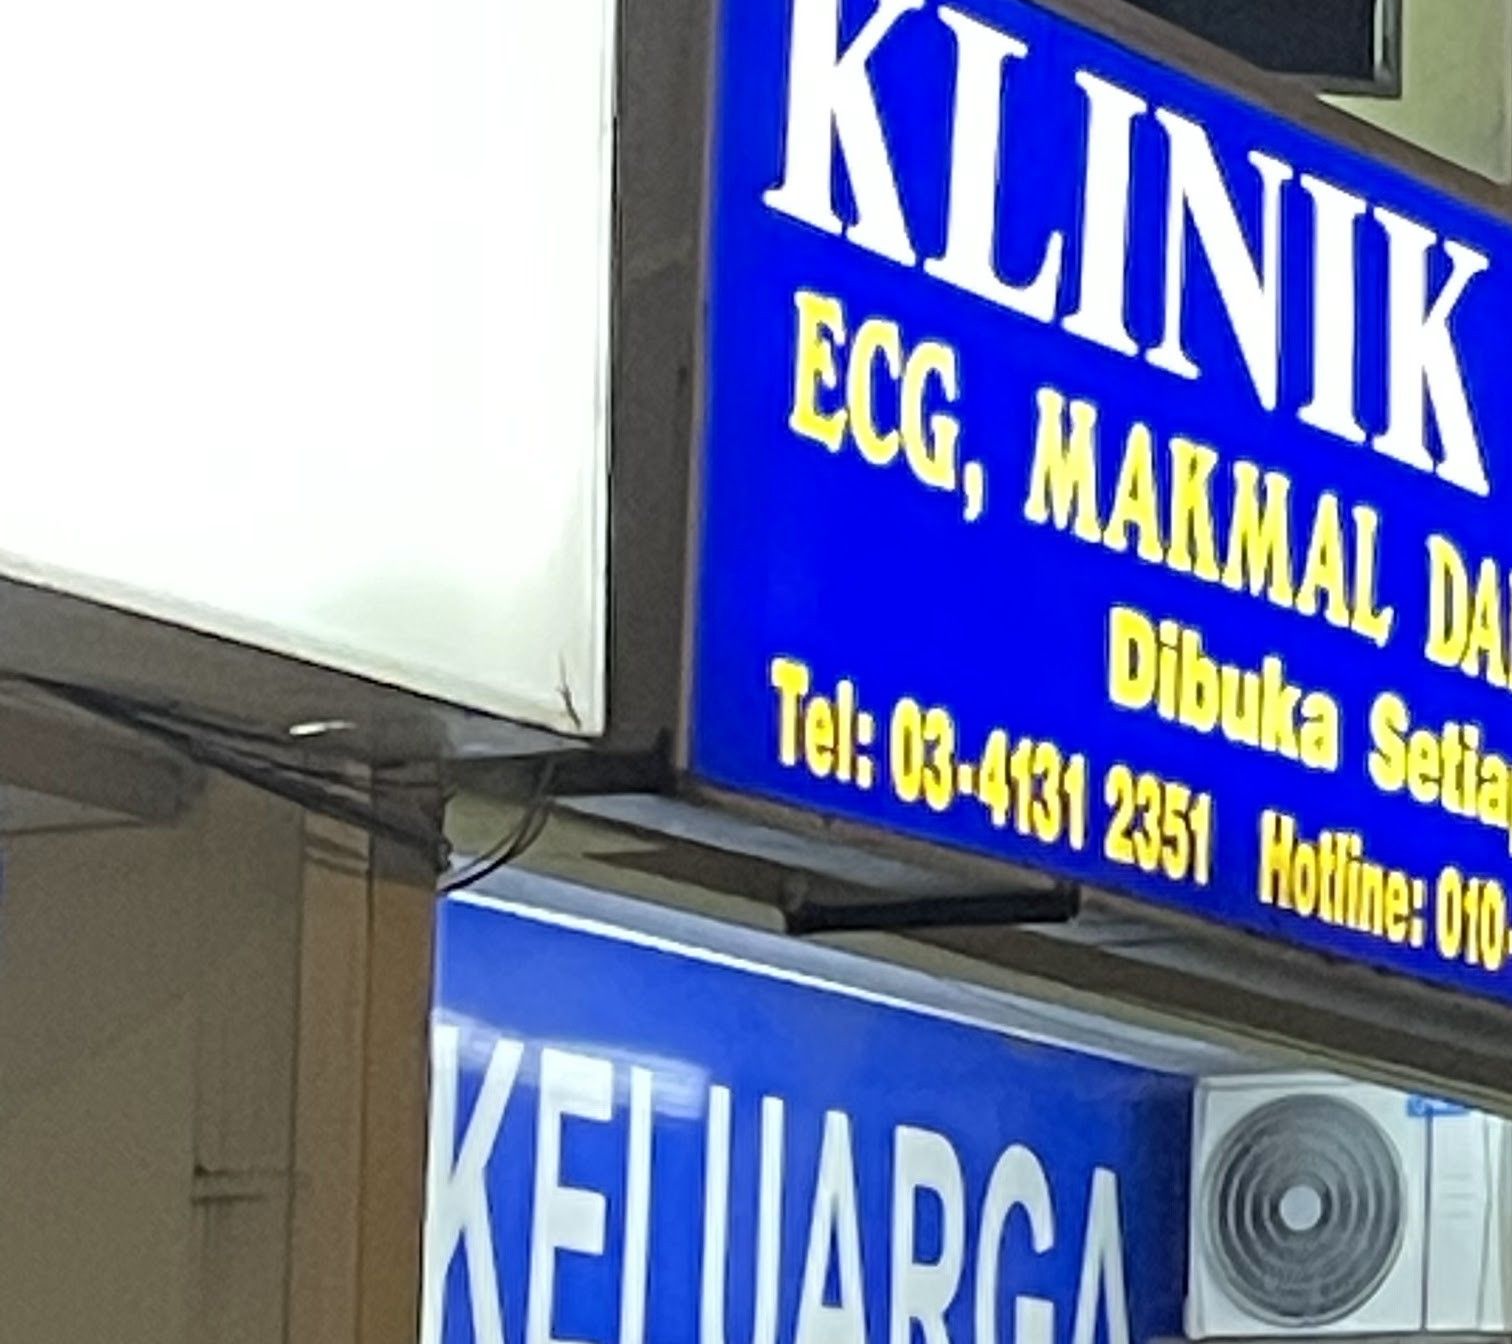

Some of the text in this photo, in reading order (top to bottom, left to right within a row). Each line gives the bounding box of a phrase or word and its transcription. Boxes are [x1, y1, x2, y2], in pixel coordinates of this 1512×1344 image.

[789, 290, 985, 521] ECG,
[1025, 388, 1393, 647] MAKMAL
[771, 659, 875, 789] Tel:
[890, 697, 1088, 850] 03-4131
[1105, 764, 1213, 885] 2351
[1259, 810, 1426, 948] Hotline:
[1108, 605, 1340, 769] Dibuka
